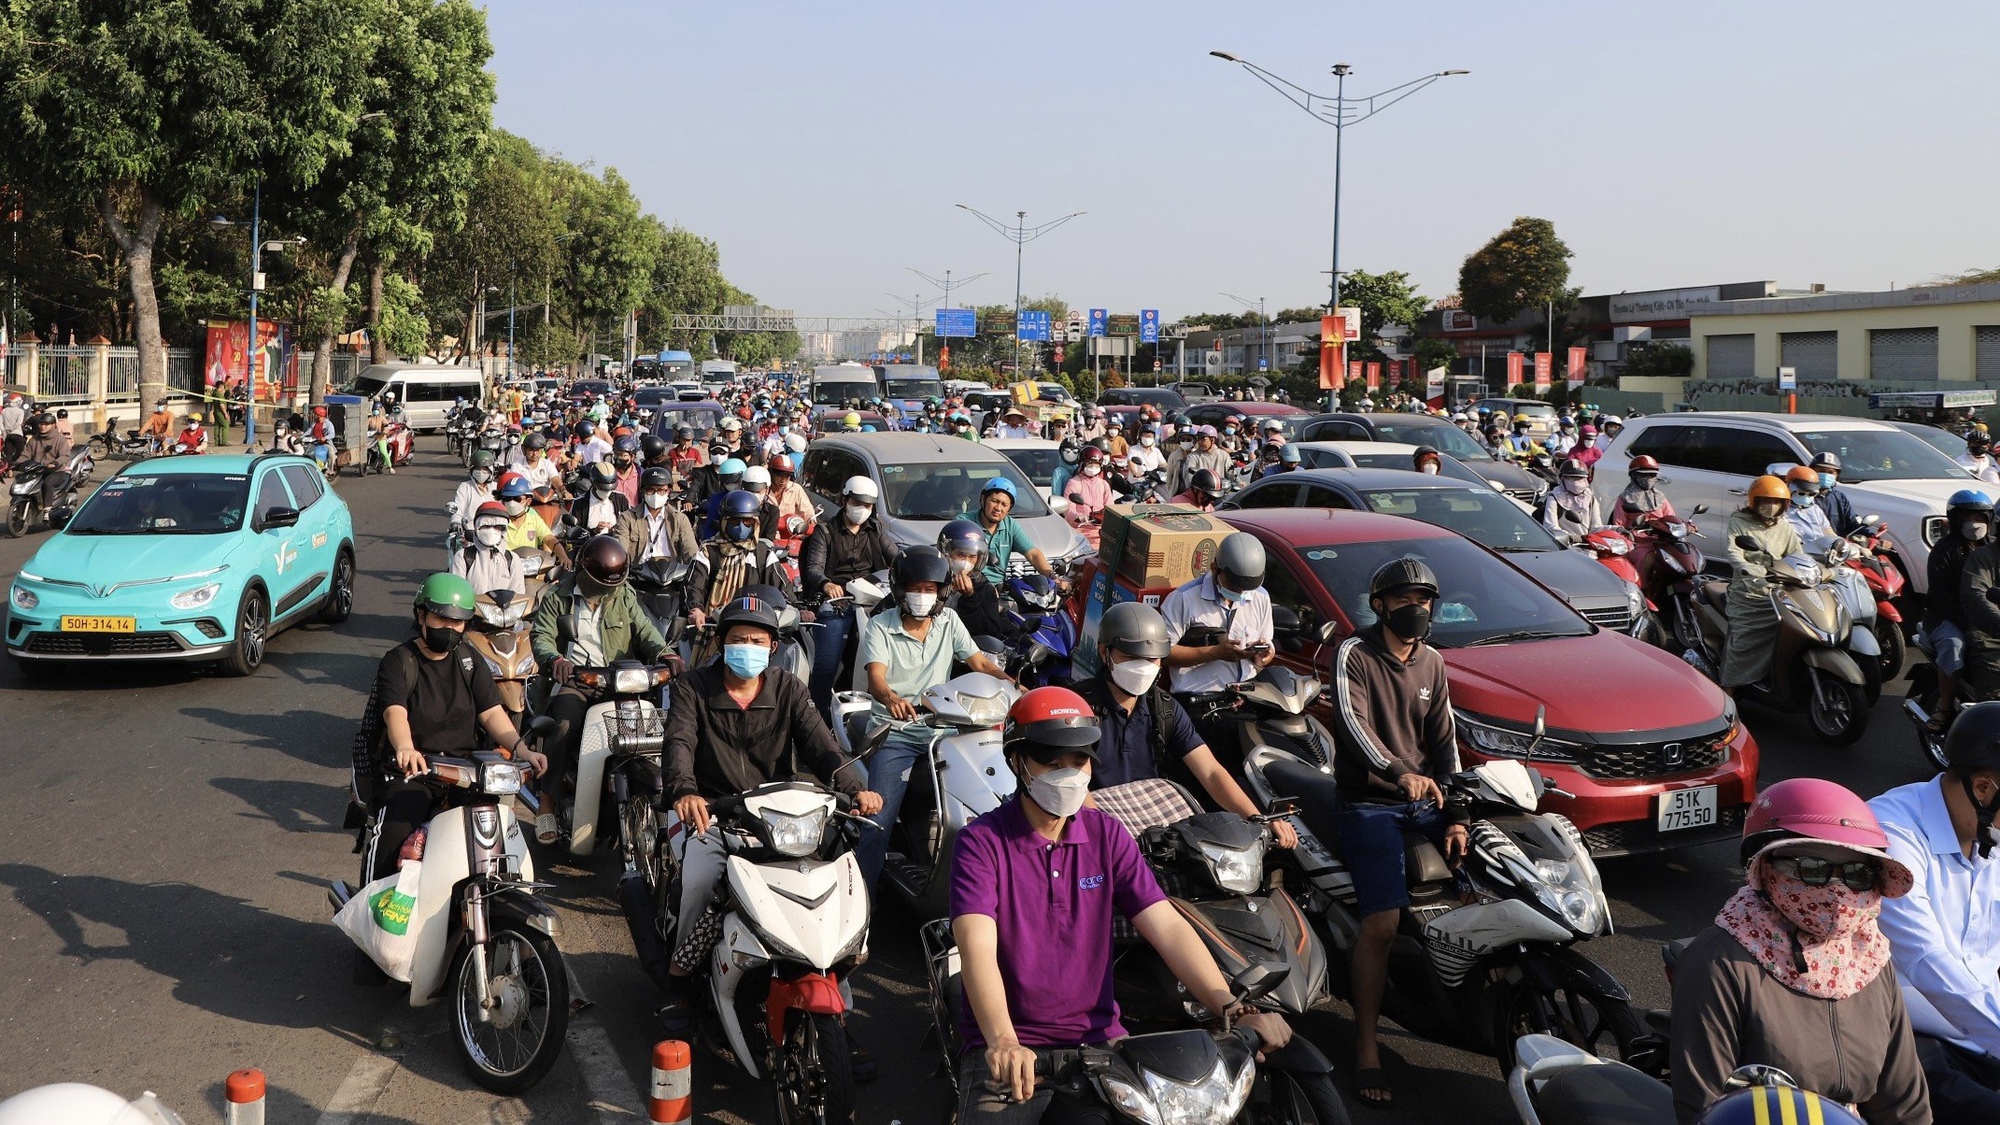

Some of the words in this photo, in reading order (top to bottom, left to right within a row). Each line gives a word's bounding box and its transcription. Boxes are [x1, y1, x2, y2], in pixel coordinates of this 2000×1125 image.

[67, 618, 129, 631] 50H-314.14
[1049, 708, 1081, 716] HONDA
[1675, 790, 1700, 809] 51K
[1665, 806, 1711, 829] 775.50
